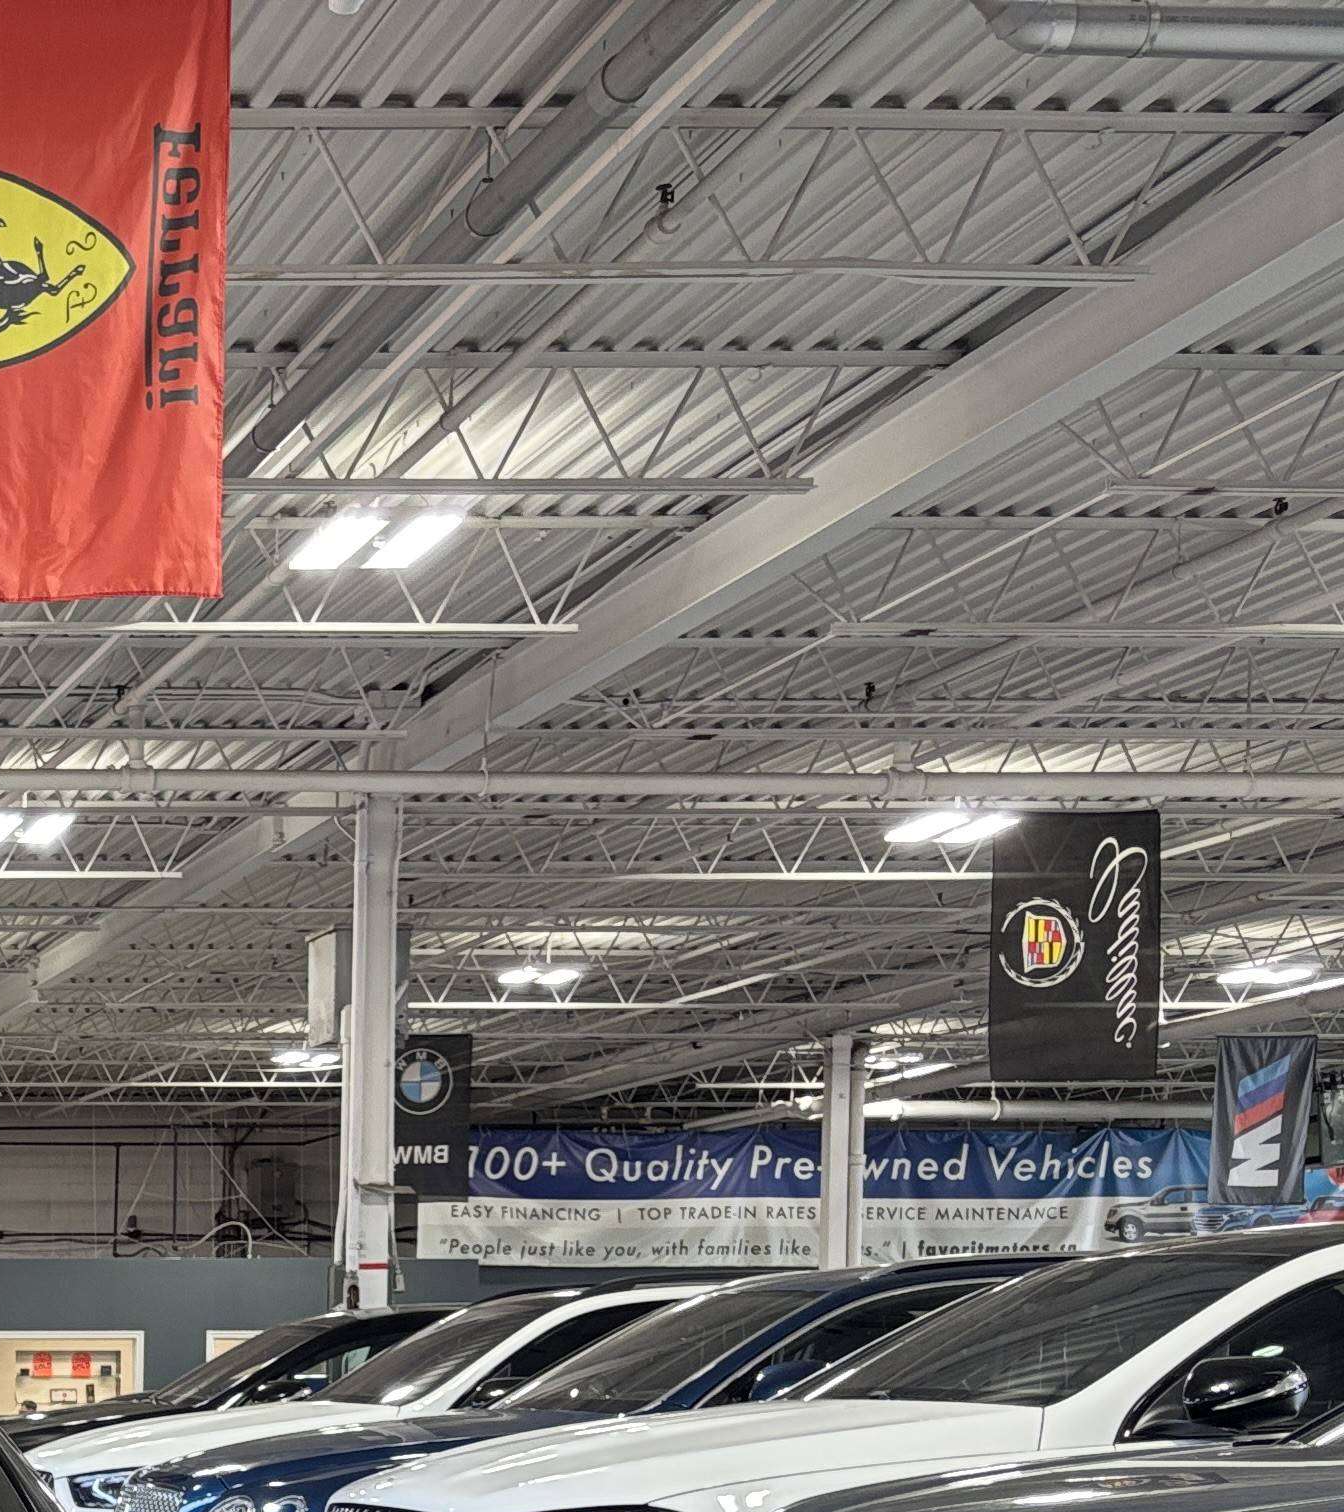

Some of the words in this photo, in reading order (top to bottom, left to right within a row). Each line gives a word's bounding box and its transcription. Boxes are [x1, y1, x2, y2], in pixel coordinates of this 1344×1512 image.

[584, 1144, 733, 1191] Quality
[988, 1140, 1153, 1182] Vehicles
[450, 1204, 495, 1219] EASY
[500, 1206, 602, 1222] FINANCING
[637, 1207, 672, 1221] TOP
[680, 1206, 757, 1220] TRADE-IN
[766, 1206, 817, 1220] RATES
[861, 1206, 927, 1221] ERVICE
[934, 1205, 1070, 1221] MAINTENANCE
[520, 1238, 556, 1259] just
[562, 1239, 596, 1257] like
[603, 1243, 643, 1261] you,
[651, 1241, 689, 1257] with
[697, 1238, 772, 1257] families
[778, 1239, 812, 1257] like
